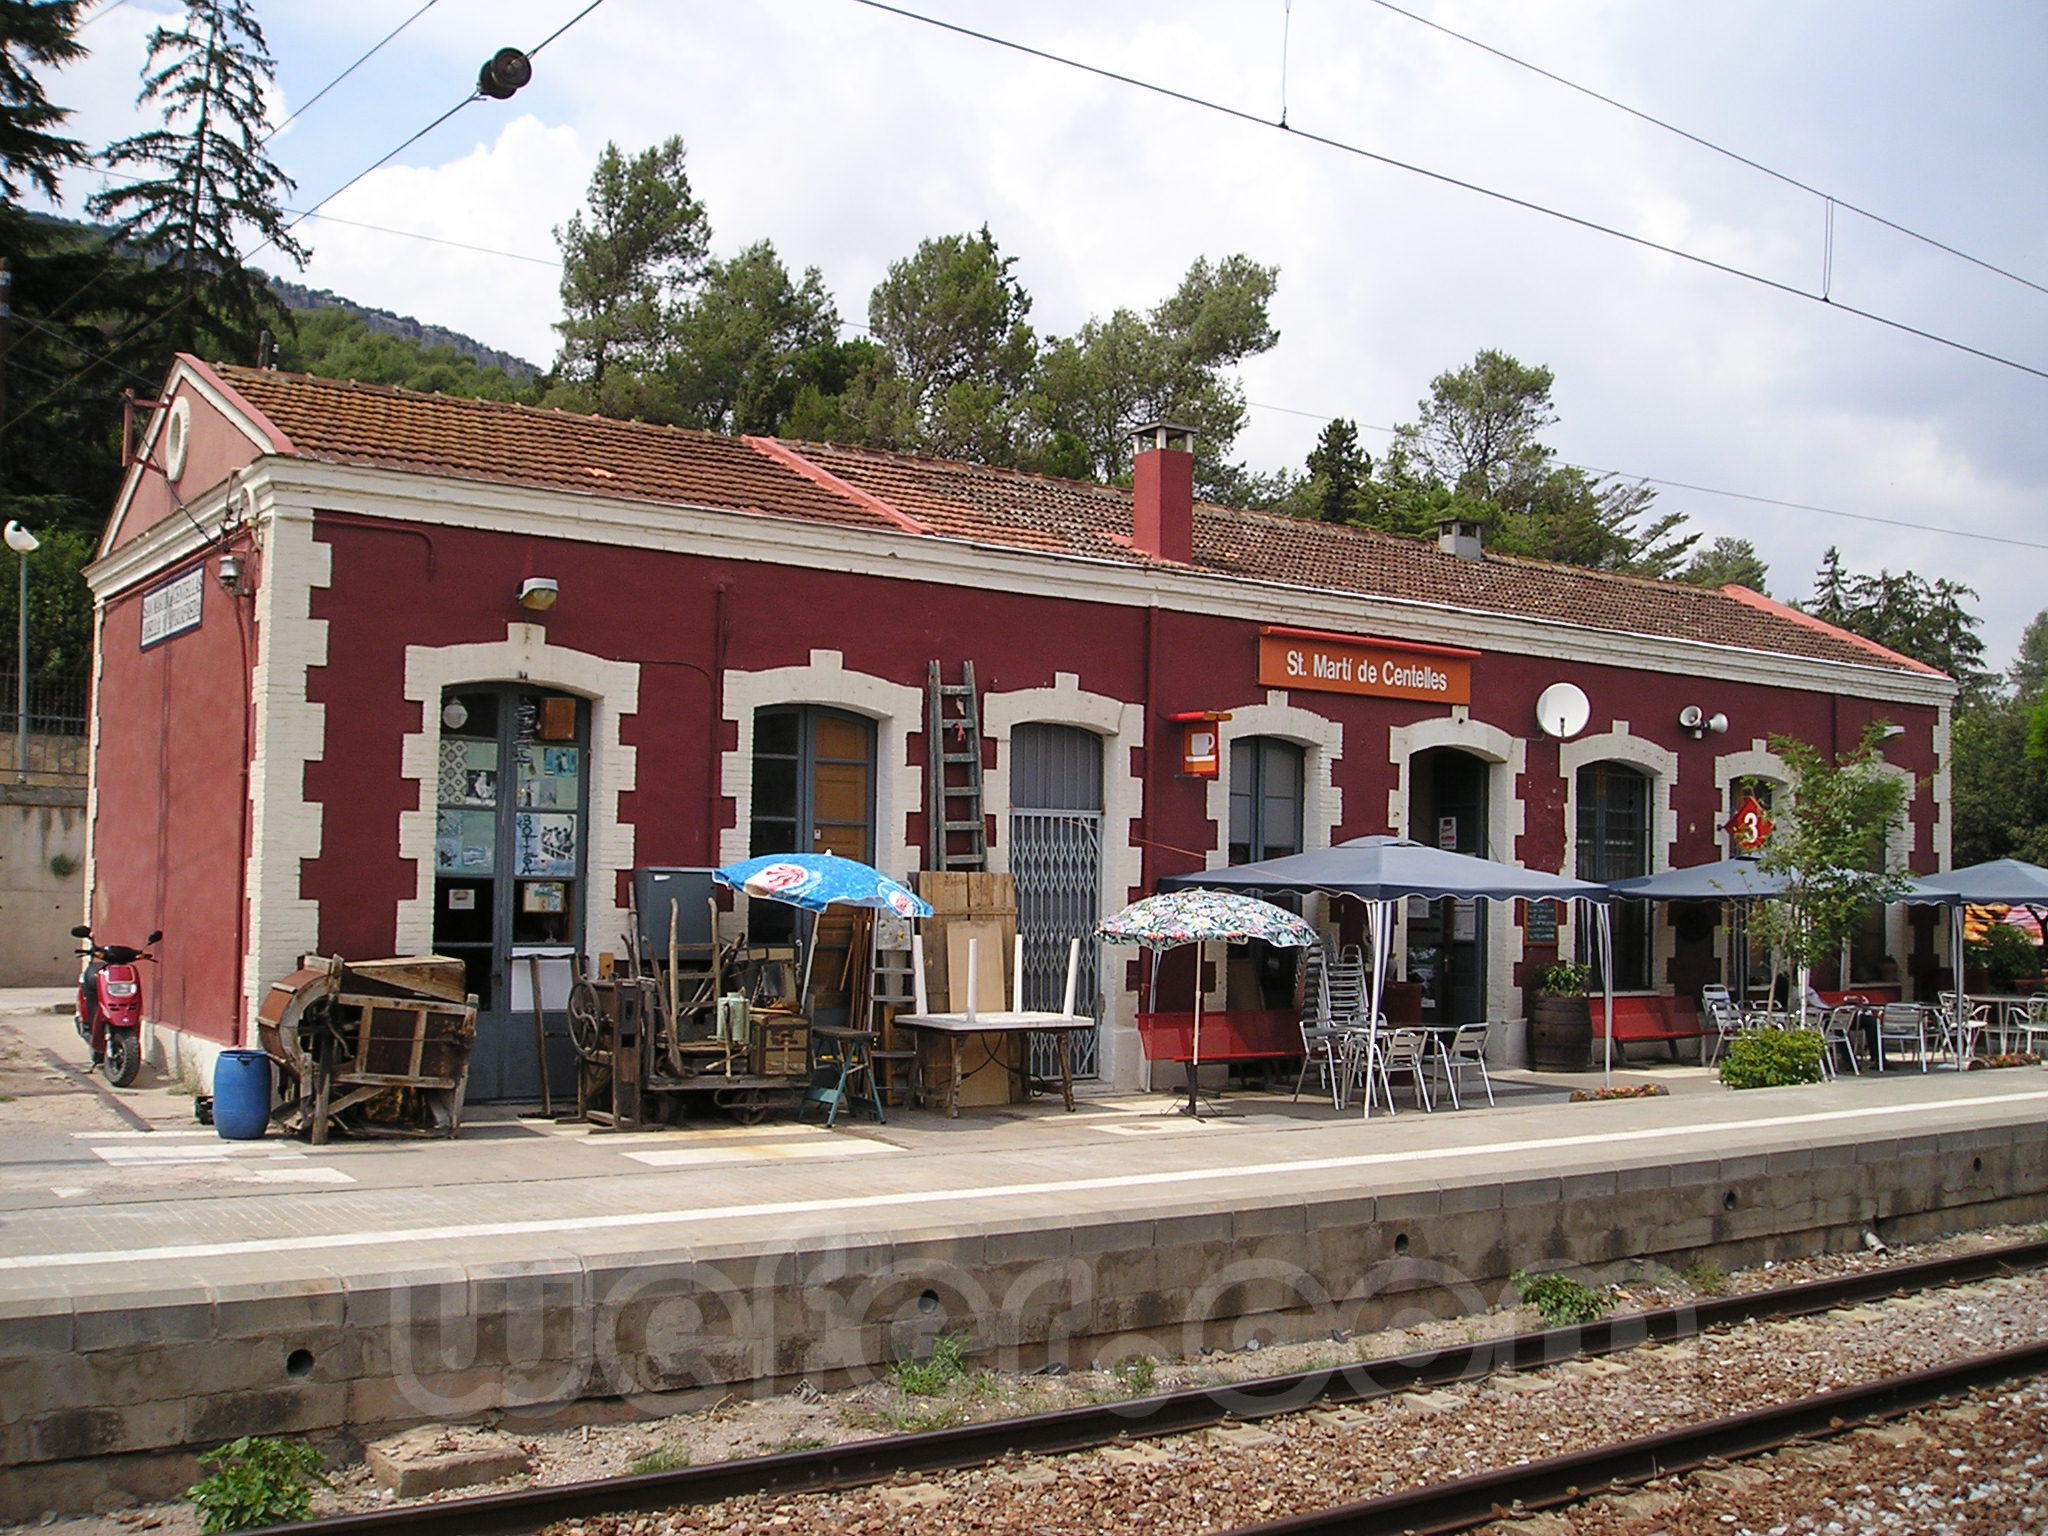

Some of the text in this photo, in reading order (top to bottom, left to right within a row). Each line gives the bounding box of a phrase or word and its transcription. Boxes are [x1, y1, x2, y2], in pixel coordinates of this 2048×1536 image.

[1287, 650, 1448, 691] St. Martí de Centelles
[1744, 812, 1759, 844] 3
